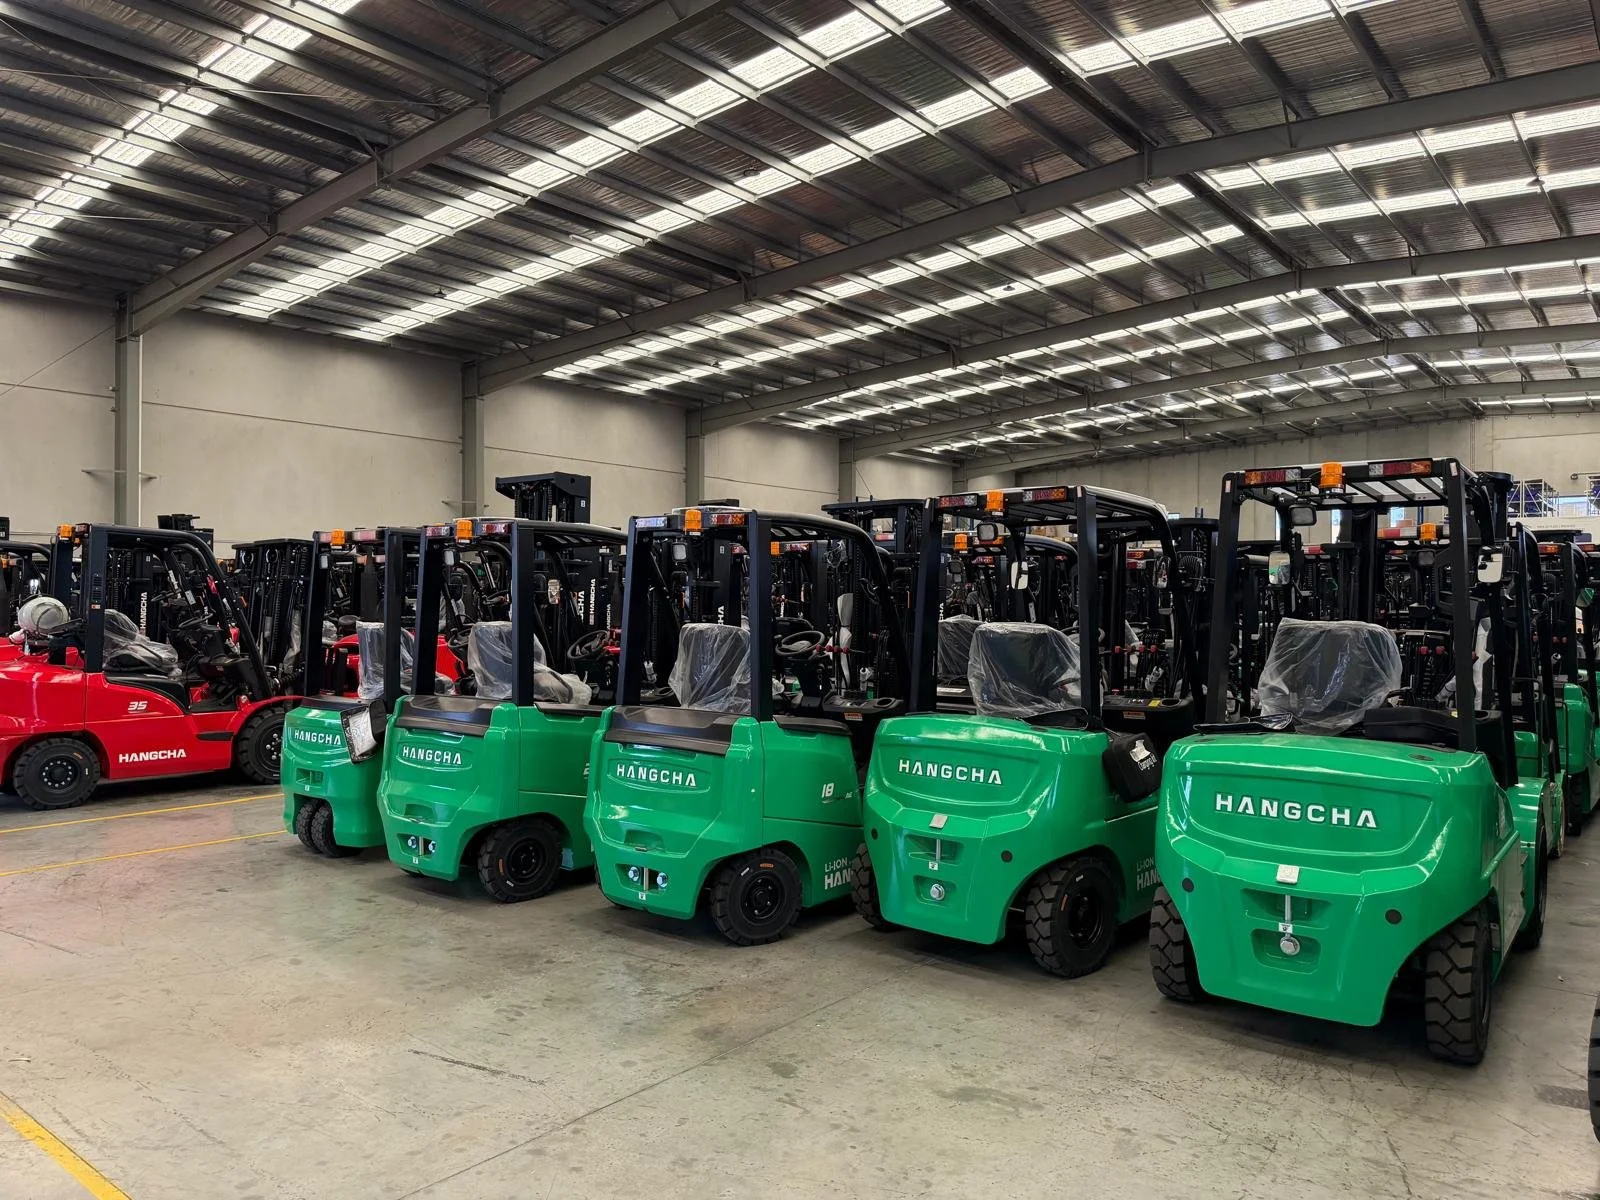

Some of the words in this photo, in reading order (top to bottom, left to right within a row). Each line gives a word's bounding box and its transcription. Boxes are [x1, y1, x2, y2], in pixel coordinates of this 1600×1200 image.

[140, 592, 148, 629] HANGCHA
[127, 700, 147, 711] 35
[294, 729, 342, 745] HANGCHA
[118, 748, 187, 763] HANGCHA
[402, 745, 462, 765] HANGCHA
[616, 763, 697, 787] HANGCHA
[898, 759, 1002, 785] HANGCHA
[1215, 793, 1377, 828] HANGCHA
